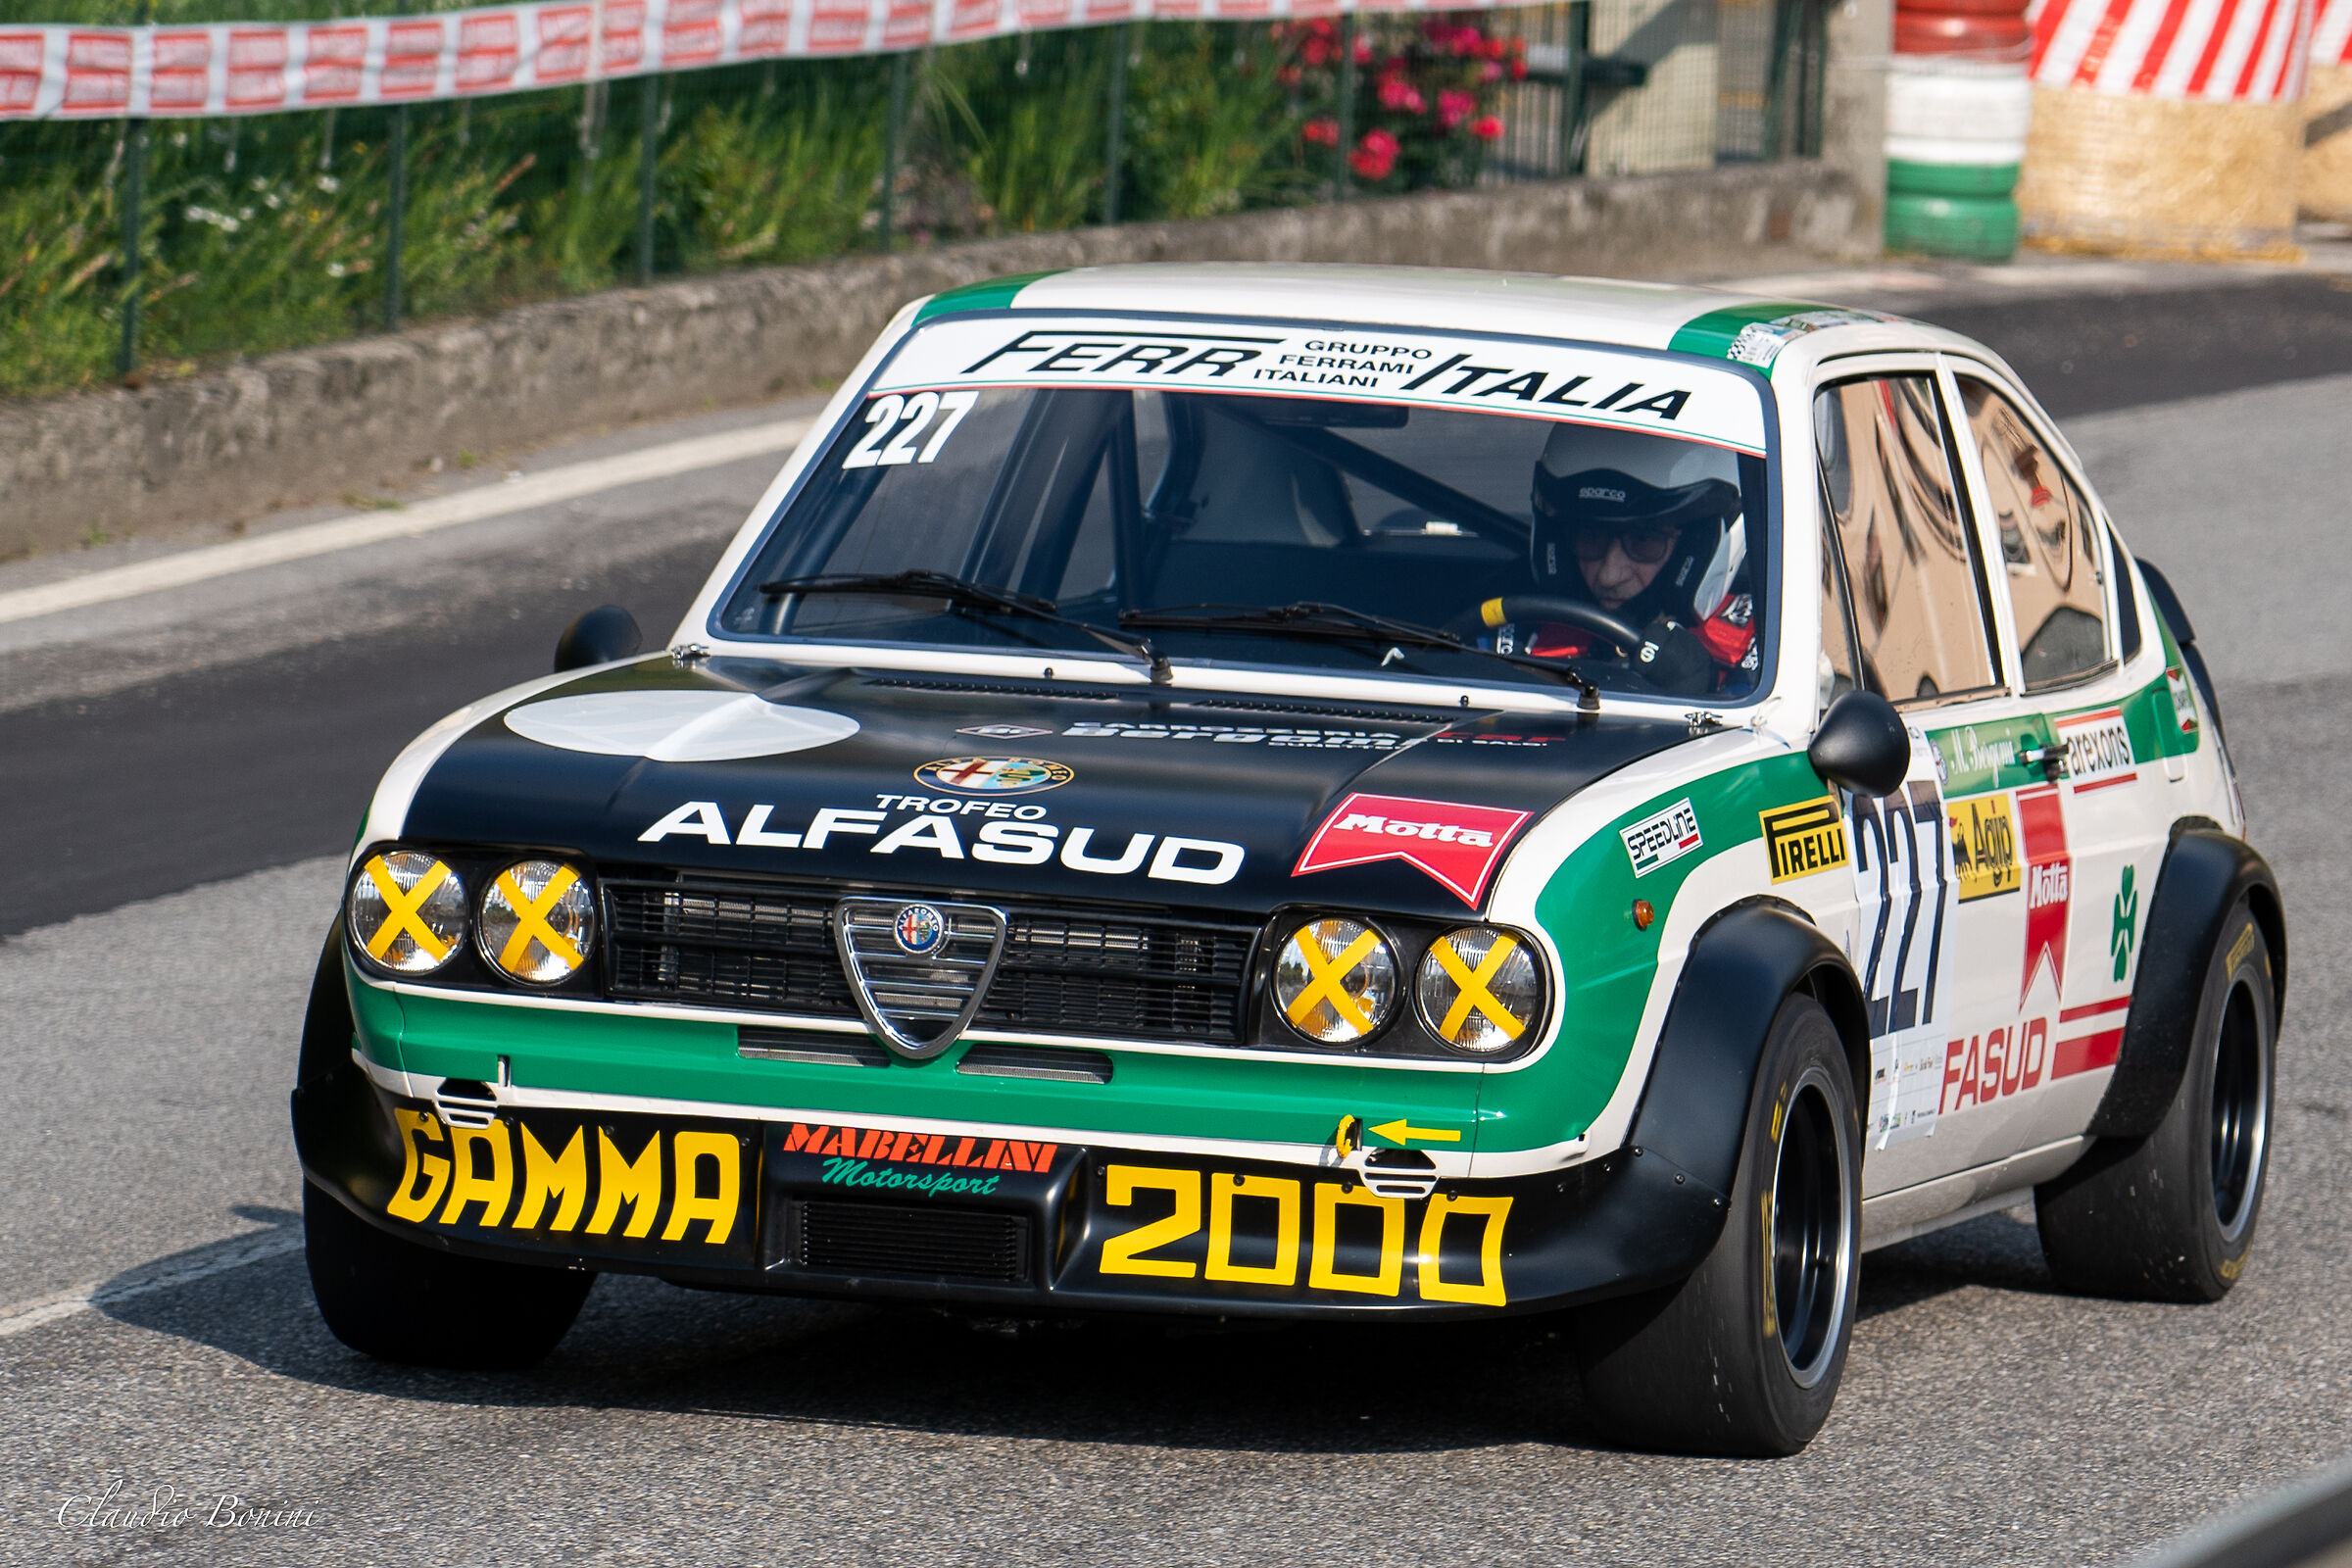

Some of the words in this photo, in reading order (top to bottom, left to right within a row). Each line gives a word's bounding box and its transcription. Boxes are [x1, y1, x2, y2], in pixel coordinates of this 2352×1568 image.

[960, 331, 1288, 377] FERR
[1279, 354, 1415, 374] FERRAMI
[1305, 339, 1433, 360] GRUPPO
[1253, 368, 1379, 388] ITALIANI
[1399, 353, 1693, 421] ITALIA
[842, 391, 980, 469] 227
[1579, 487, 1627, 502] sparco
[2067, 726, 2132, 776] arexons
[875, 795, 1048, 821] TROFEO
[1333, 813, 1494, 848] Motta
[637, 801, 1246, 886] ALFASUD
[1763, 800, 1847, 880] PIRELLI
[1971, 799, 2014, 888] Agip
[1851, 780, 1947, 1042] 227
[2030, 862, 2070, 910] Motta
[783, 1123, 1059, 1174] MABELLINI
[387, 1107, 740, 1246] GAMMA
[822, 1156, 999, 1199] Motorsport
[1100, 1164, 1514, 1307] 2000
